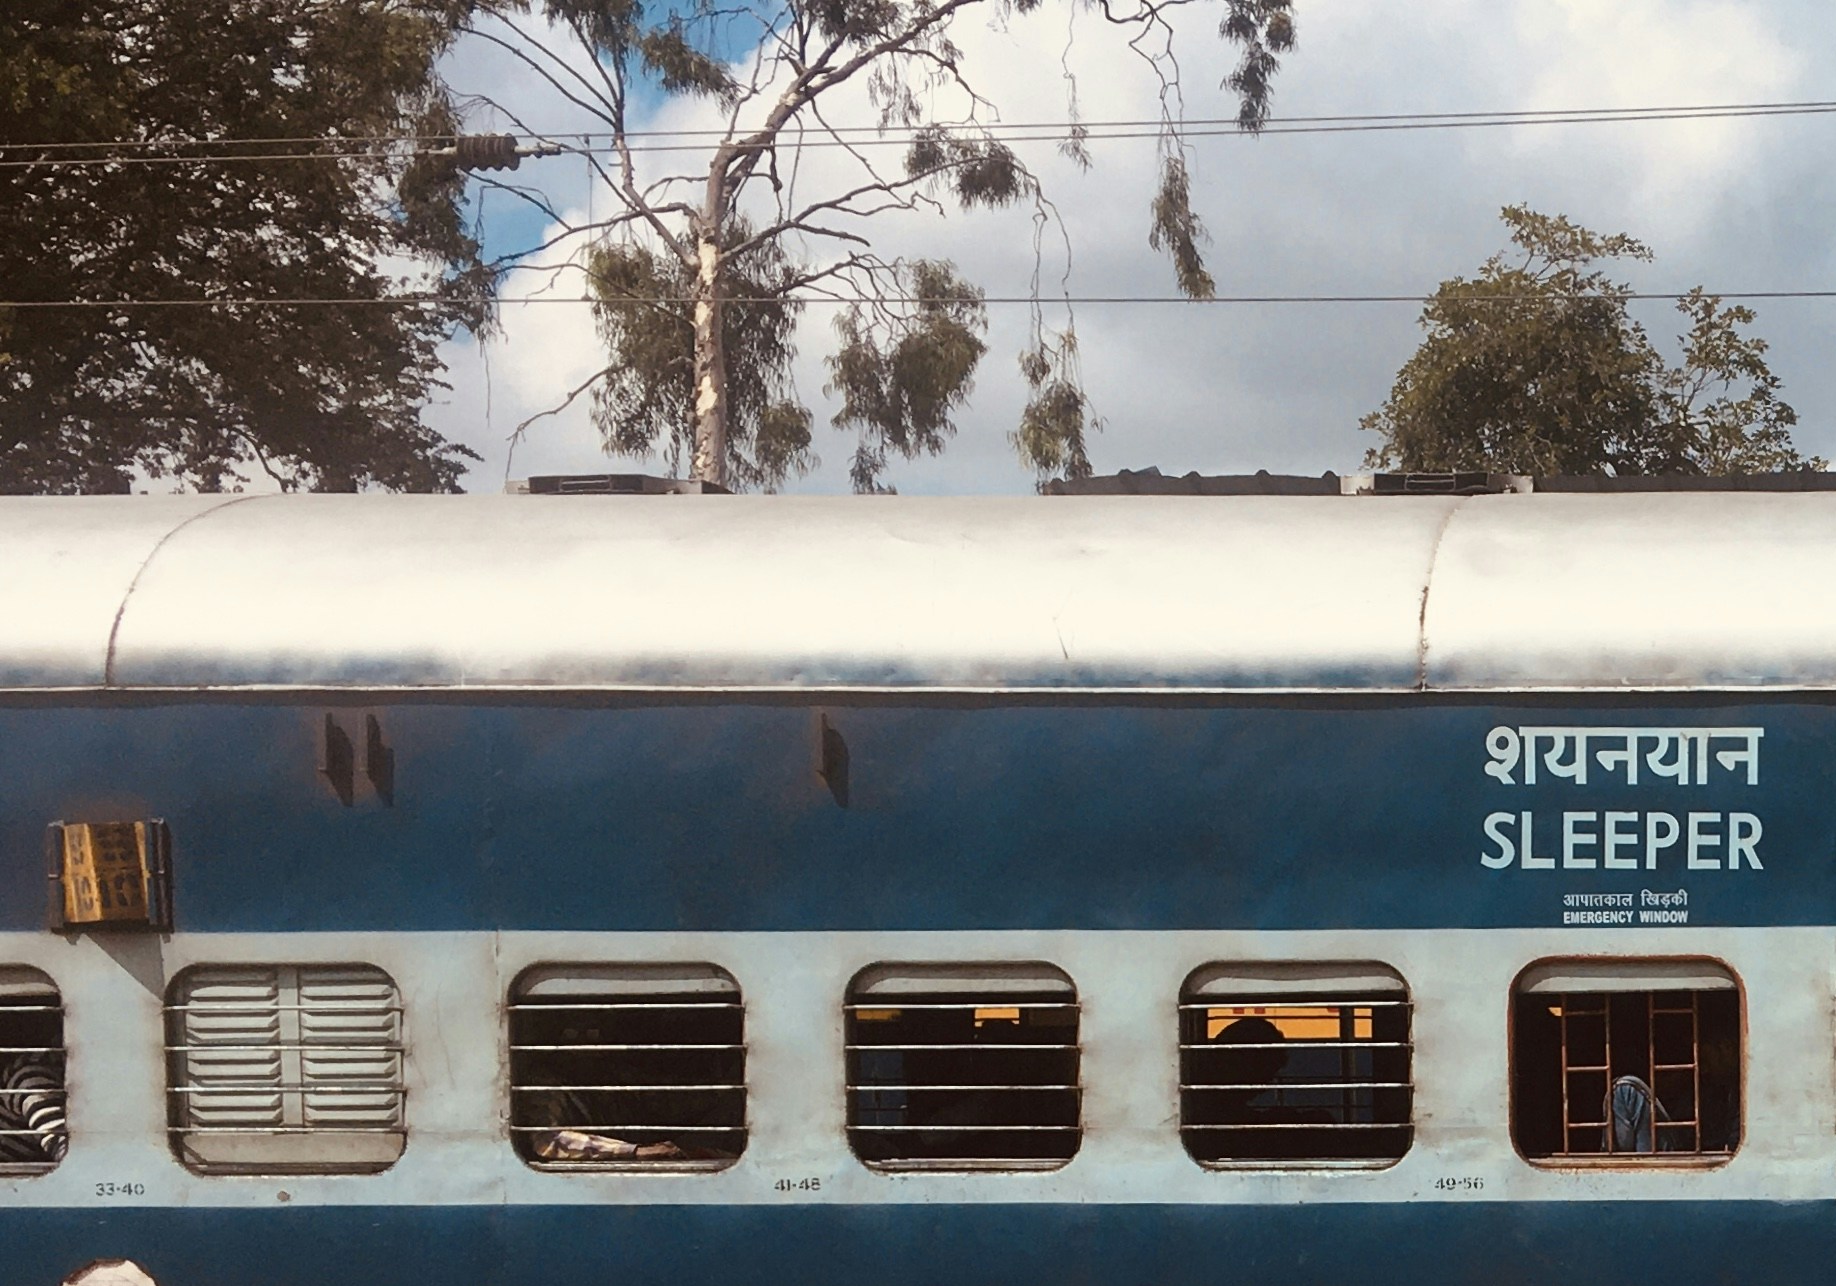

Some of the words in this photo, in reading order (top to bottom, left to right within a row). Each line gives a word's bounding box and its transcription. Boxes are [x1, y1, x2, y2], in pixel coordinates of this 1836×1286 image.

[1484, 726, 1765, 785] शयनयान
[1480, 811, 1764, 870] SLEEPER
[1562, 893, 1634, 907] आपातकाल
[1640, 889, 1688, 909] खिड़की
[1563, 910, 1634, 924] EMERGENCY
[1639, 910, 1689, 923] WINDOW
